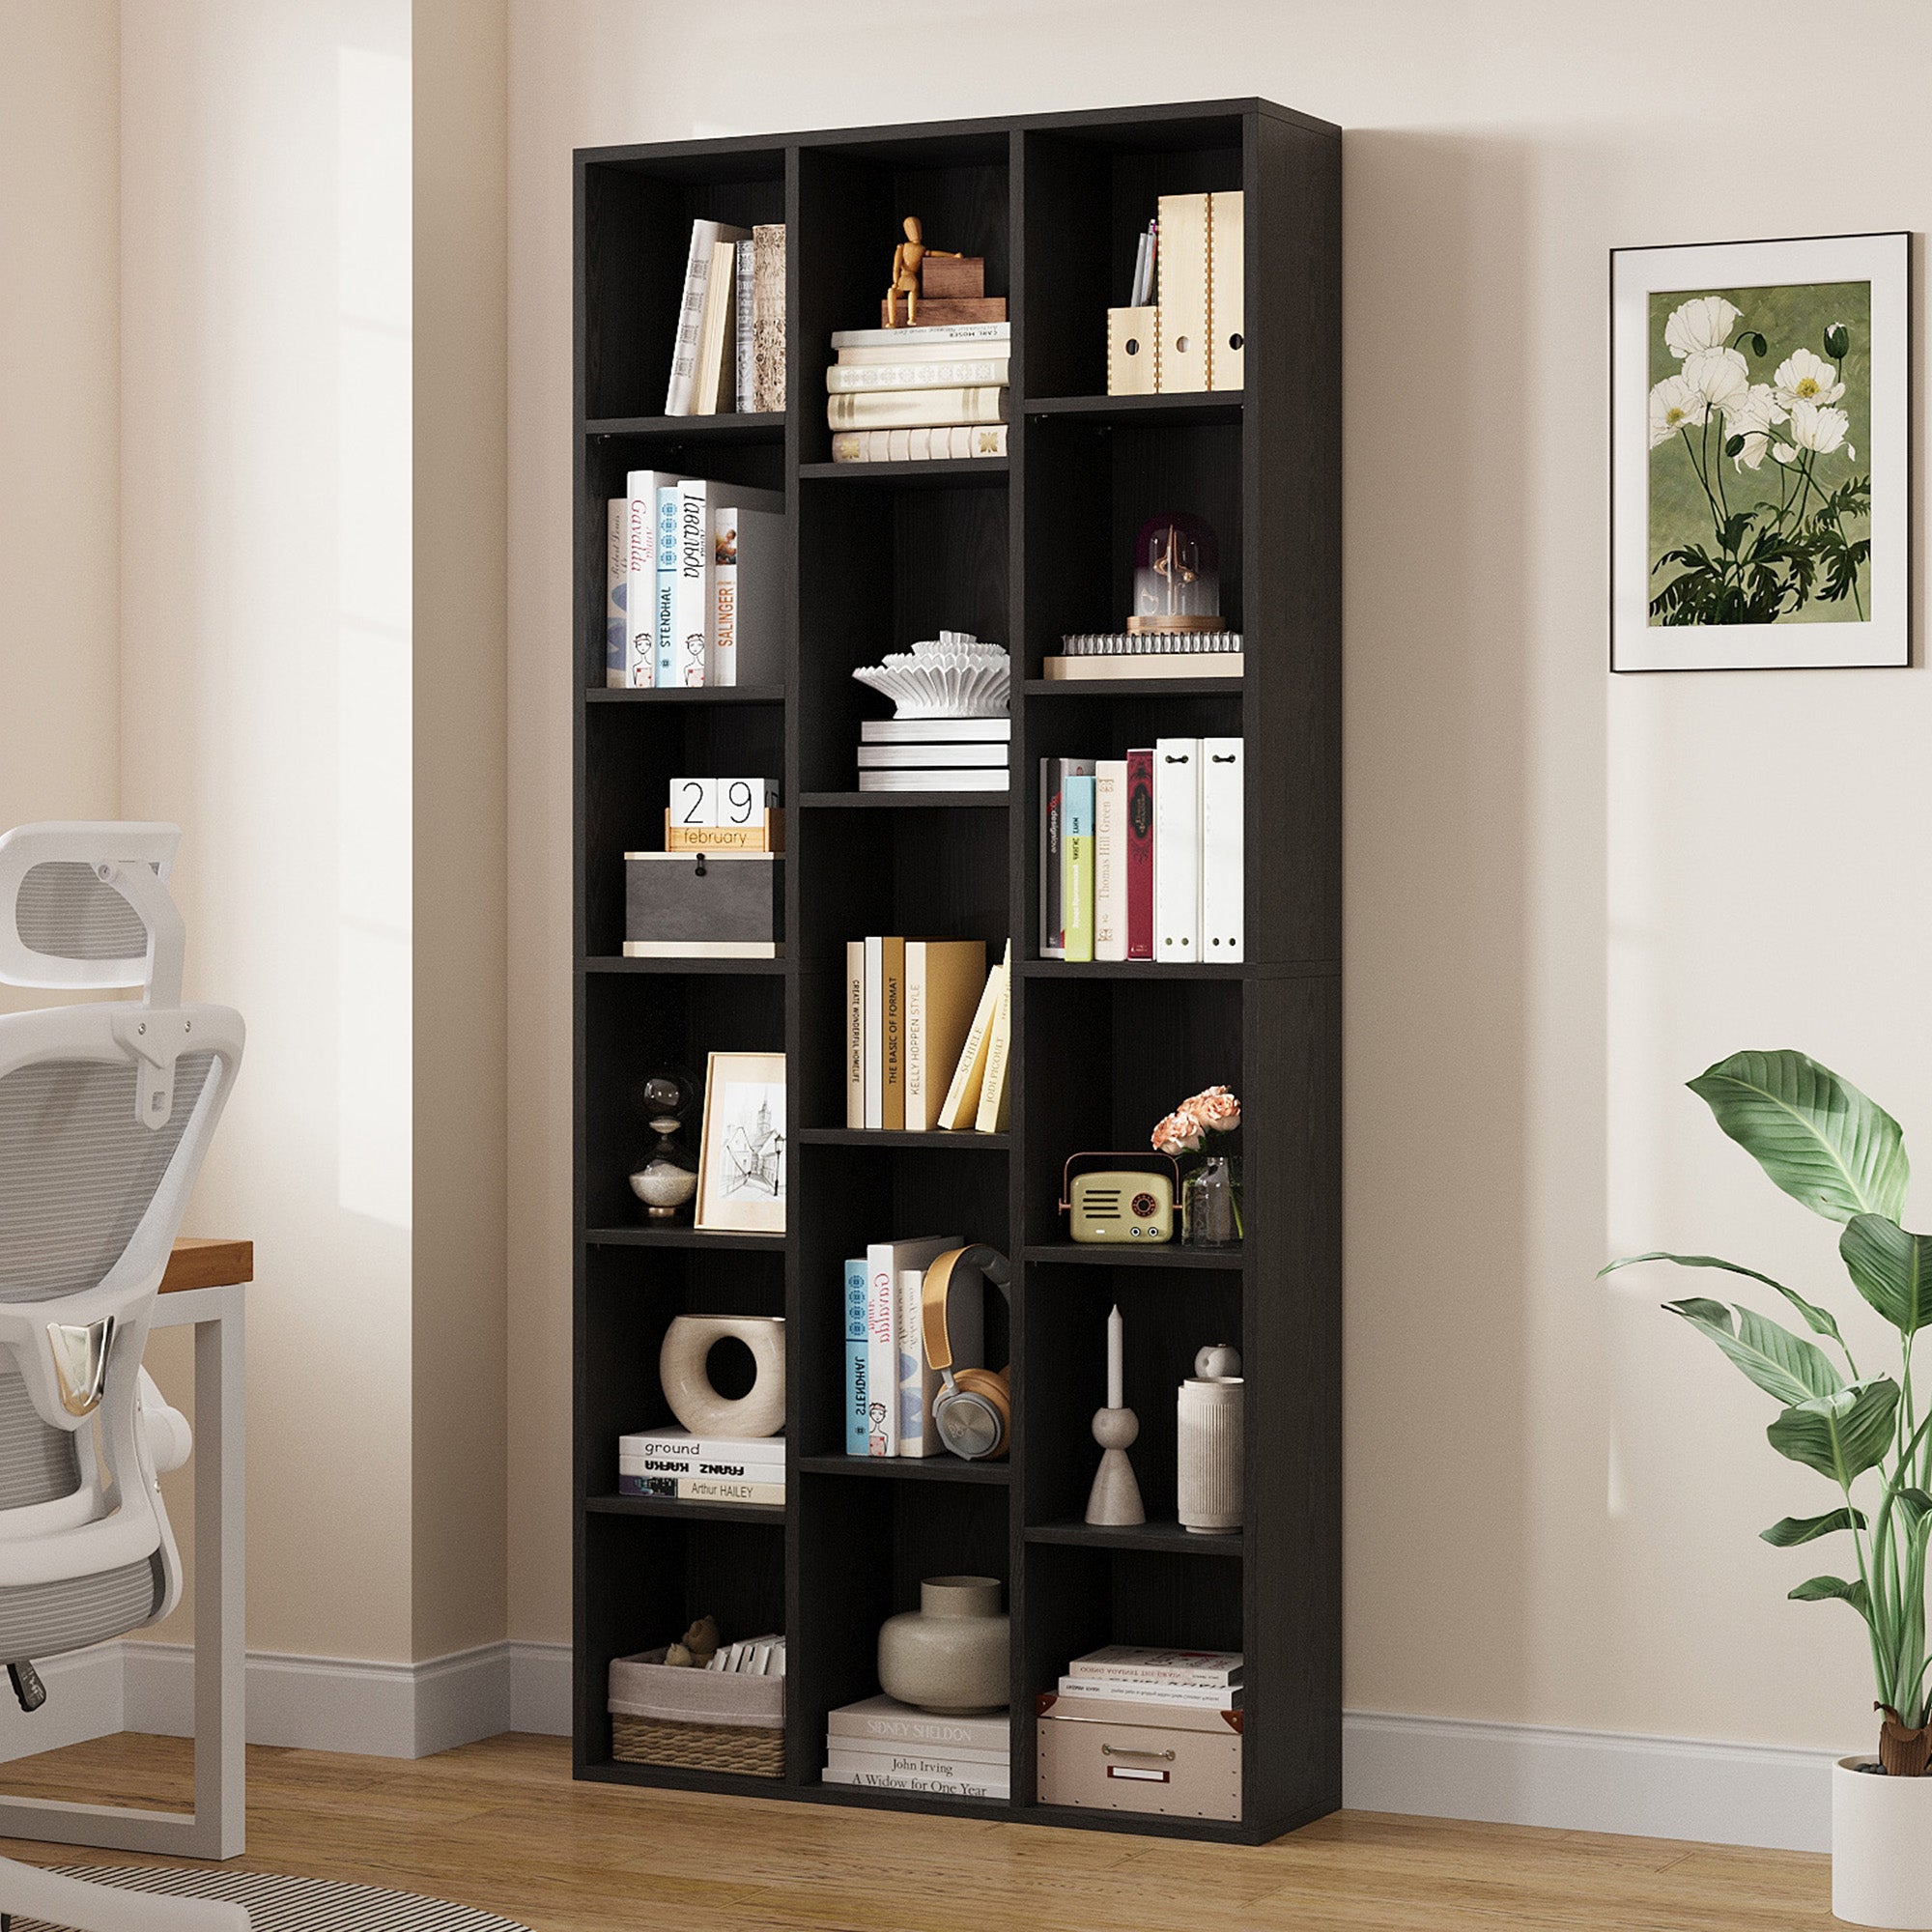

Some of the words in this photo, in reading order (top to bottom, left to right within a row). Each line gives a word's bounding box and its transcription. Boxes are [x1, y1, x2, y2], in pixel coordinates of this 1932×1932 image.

[631, 499, 648, 572] Gavalda
[661, 586, 671, 648] STENDHAL
[718, 587, 733, 646] SALINGER
[1098, 801, 1111, 833] Green
[684, 828, 747, 847] february
[1098, 836, 1110, 856] Hill
[1098, 859, 1110, 900] Thomas
[889, 977, 897, 1017] FORMAT
[910, 984, 919, 1015] STYLE
[889, 1020, 897, 1033] OF
[889, 1037, 897, 1063] BASIC
[910, 1019, 919, 1061] HOPPEN
[960, 1026, 983, 1074] SCHIELE
[989, 1037, 1004, 1079] PICOULT
[889, 1066, 897, 1084] THE
[910, 1064, 919, 1095] KELLY
[985, 1081, 997, 1103] JODI
[645, 1442, 700, 1456] ground
[645, 1461, 689, 1472] KAFKA
[699, 1463, 745, 1476] FRANZ
[692, 1483, 718, 1495] Arthur
[720, 1486, 753, 1498] HAILEY
[867, 1720, 910, 1736] SIDNEY
[913, 1724, 972, 1741] SHELDON
[892, 1758, 917, 1772] John
[920, 1761, 953, 1776] Irving
[852, 1773, 862, 1784] A
[866, 1774, 908, 1789] Widow
[911, 1777, 927, 1790] for
[930, 1779, 956, 1794] One
[960, 1783, 987, 1796] Year
